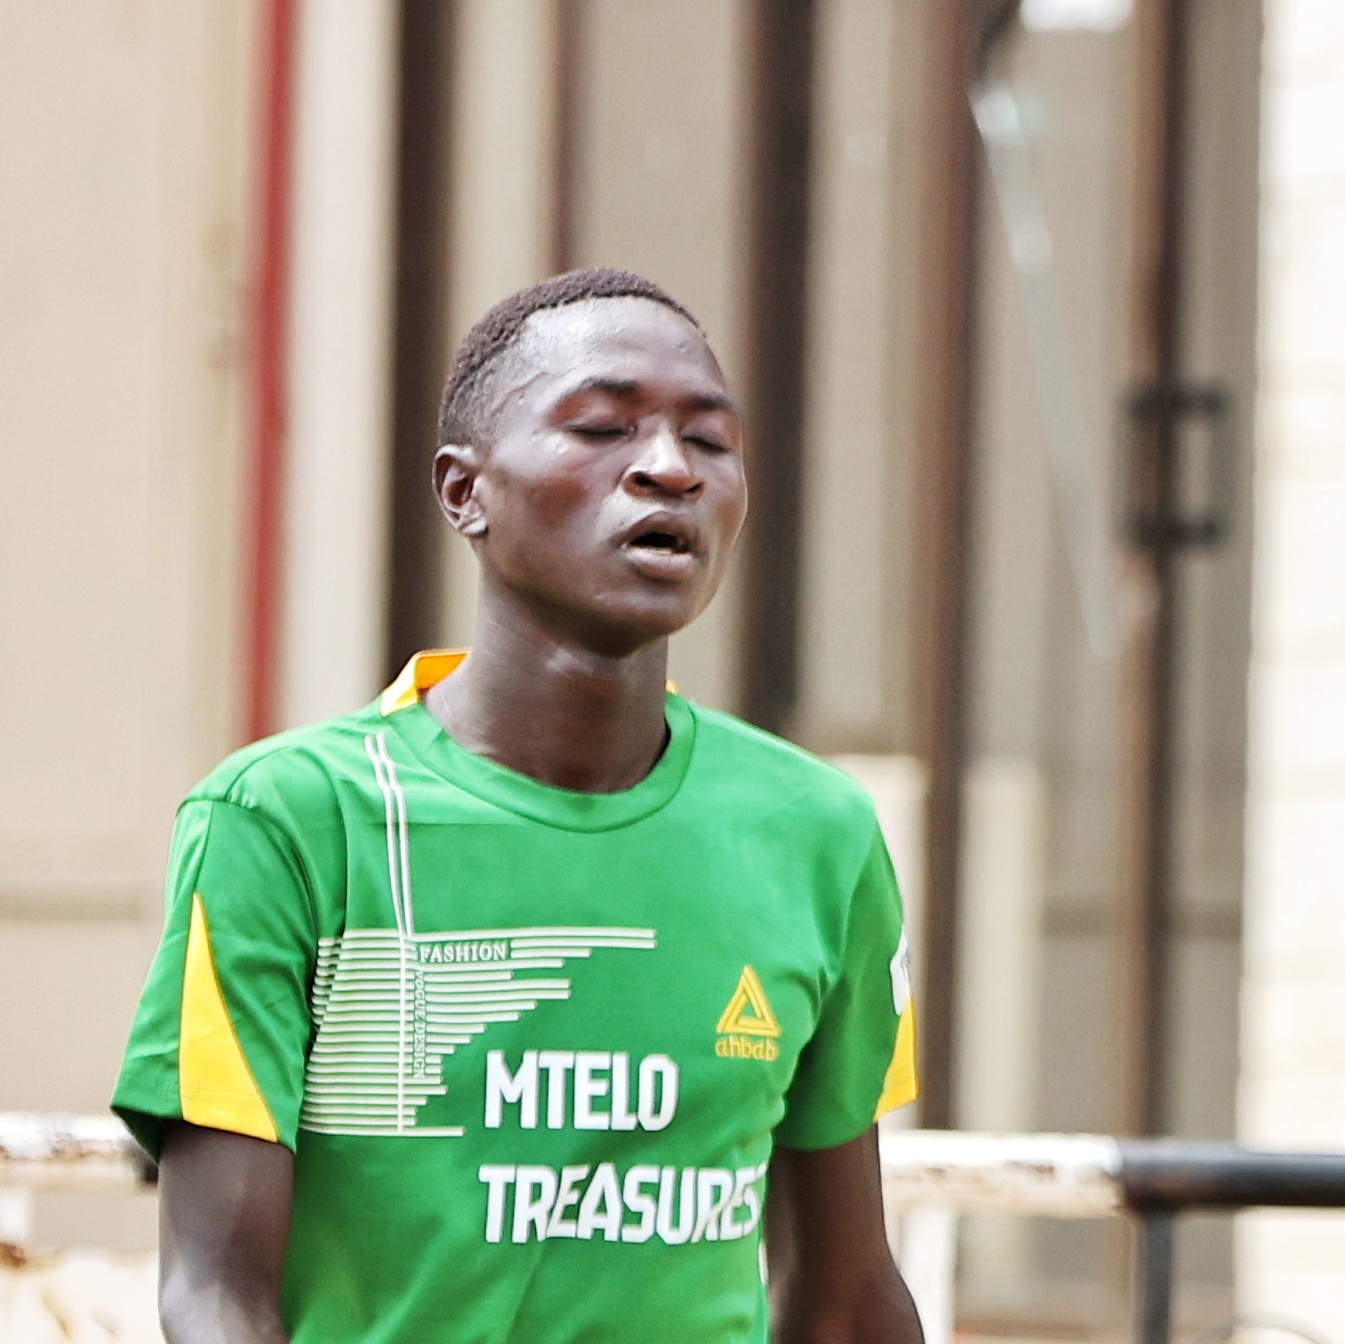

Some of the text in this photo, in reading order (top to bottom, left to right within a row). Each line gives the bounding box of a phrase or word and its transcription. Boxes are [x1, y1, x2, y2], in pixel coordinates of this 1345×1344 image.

[419, 942, 507, 963] FASHION
[413, 971, 426, 1080] VOGUE DESIGN
[715, 1035, 779, 1062] ahbab
[485, 1049, 679, 1130] MTELO
